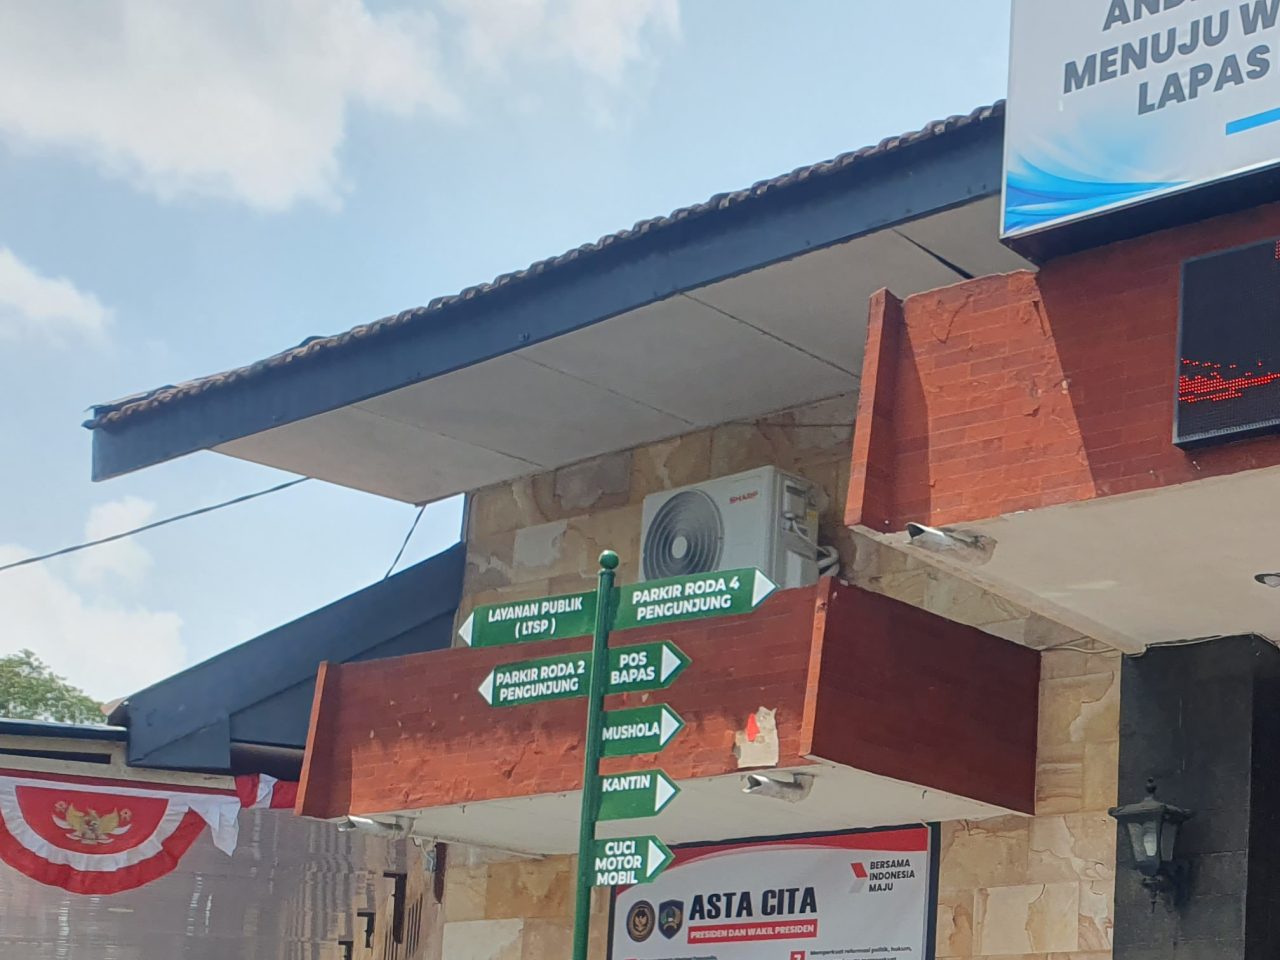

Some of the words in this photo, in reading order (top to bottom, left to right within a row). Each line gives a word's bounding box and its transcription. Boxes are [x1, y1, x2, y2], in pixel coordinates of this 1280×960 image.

[1063, 9, 1229, 94] MENUJU
[1138, 44, 1271, 116] LAPAS
[632, 584, 682, 605] PARKIR
[684, 579, 726, 596] RODA
[729, 576, 740, 590] 4
[488, 601, 539, 623] LAYANAN
[541, 597, 583, 615] PUBLIK
[636, 596, 732, 621] PENGUNJUNG
[619, 653, 647, 668] POS
[496, 667, 538, 686] PARKIR
[540, 663, 574, 679] RODA
[577, 660, 586, 675] 2
[610, 666, 655, 685] BAPAS
[499, 678, 580, 702] PENGUNJUNG
[602, 722, 660, 741] MUSHOLA
[602, 775, 650, 792] KANTIN
[604, 841, 636, 855] CUCI
[595, 856, 643, 872] MOTOR
[869, 859, 911, 871] BERSAMA
[596, 871, 638, 886] MOBIL
[869, 870, 916, 882] INDONESIA
[868, 882, 894, 893] MAJU
[689, 892, 753, 920] ASTA
[761, 887, 818, 916] CITA
[690, 928, 727, 939] PRESIDEN
[729, 927, 746, 937] DAN
[748, 926, 774, 936] WAKIL
[775, 924, 815, 935] PRESIDEN
